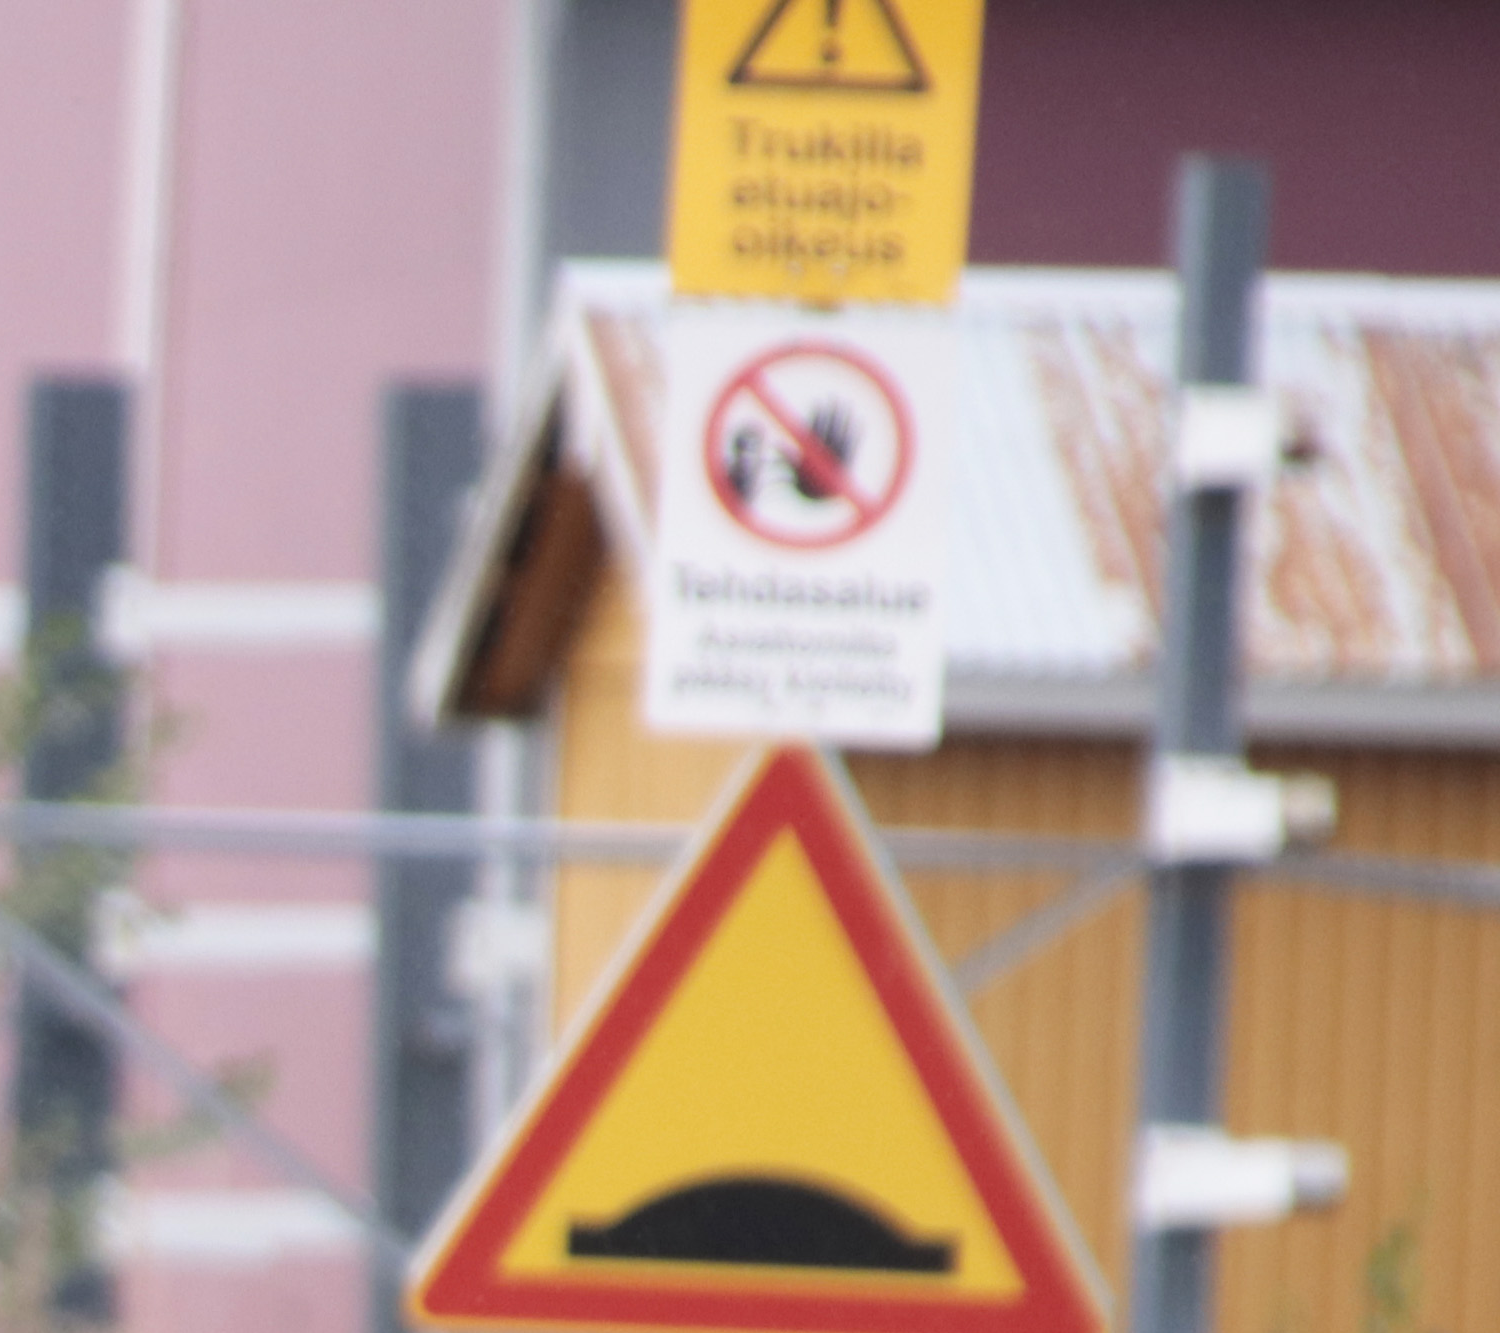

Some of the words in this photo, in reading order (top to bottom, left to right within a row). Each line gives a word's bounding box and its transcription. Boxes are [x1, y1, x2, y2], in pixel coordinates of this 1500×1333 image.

[729, 116, 924, 166] Trukilla
[731, 218, 904, 262] oikeus
[673, 562, 931, 611] Tehdasalue
